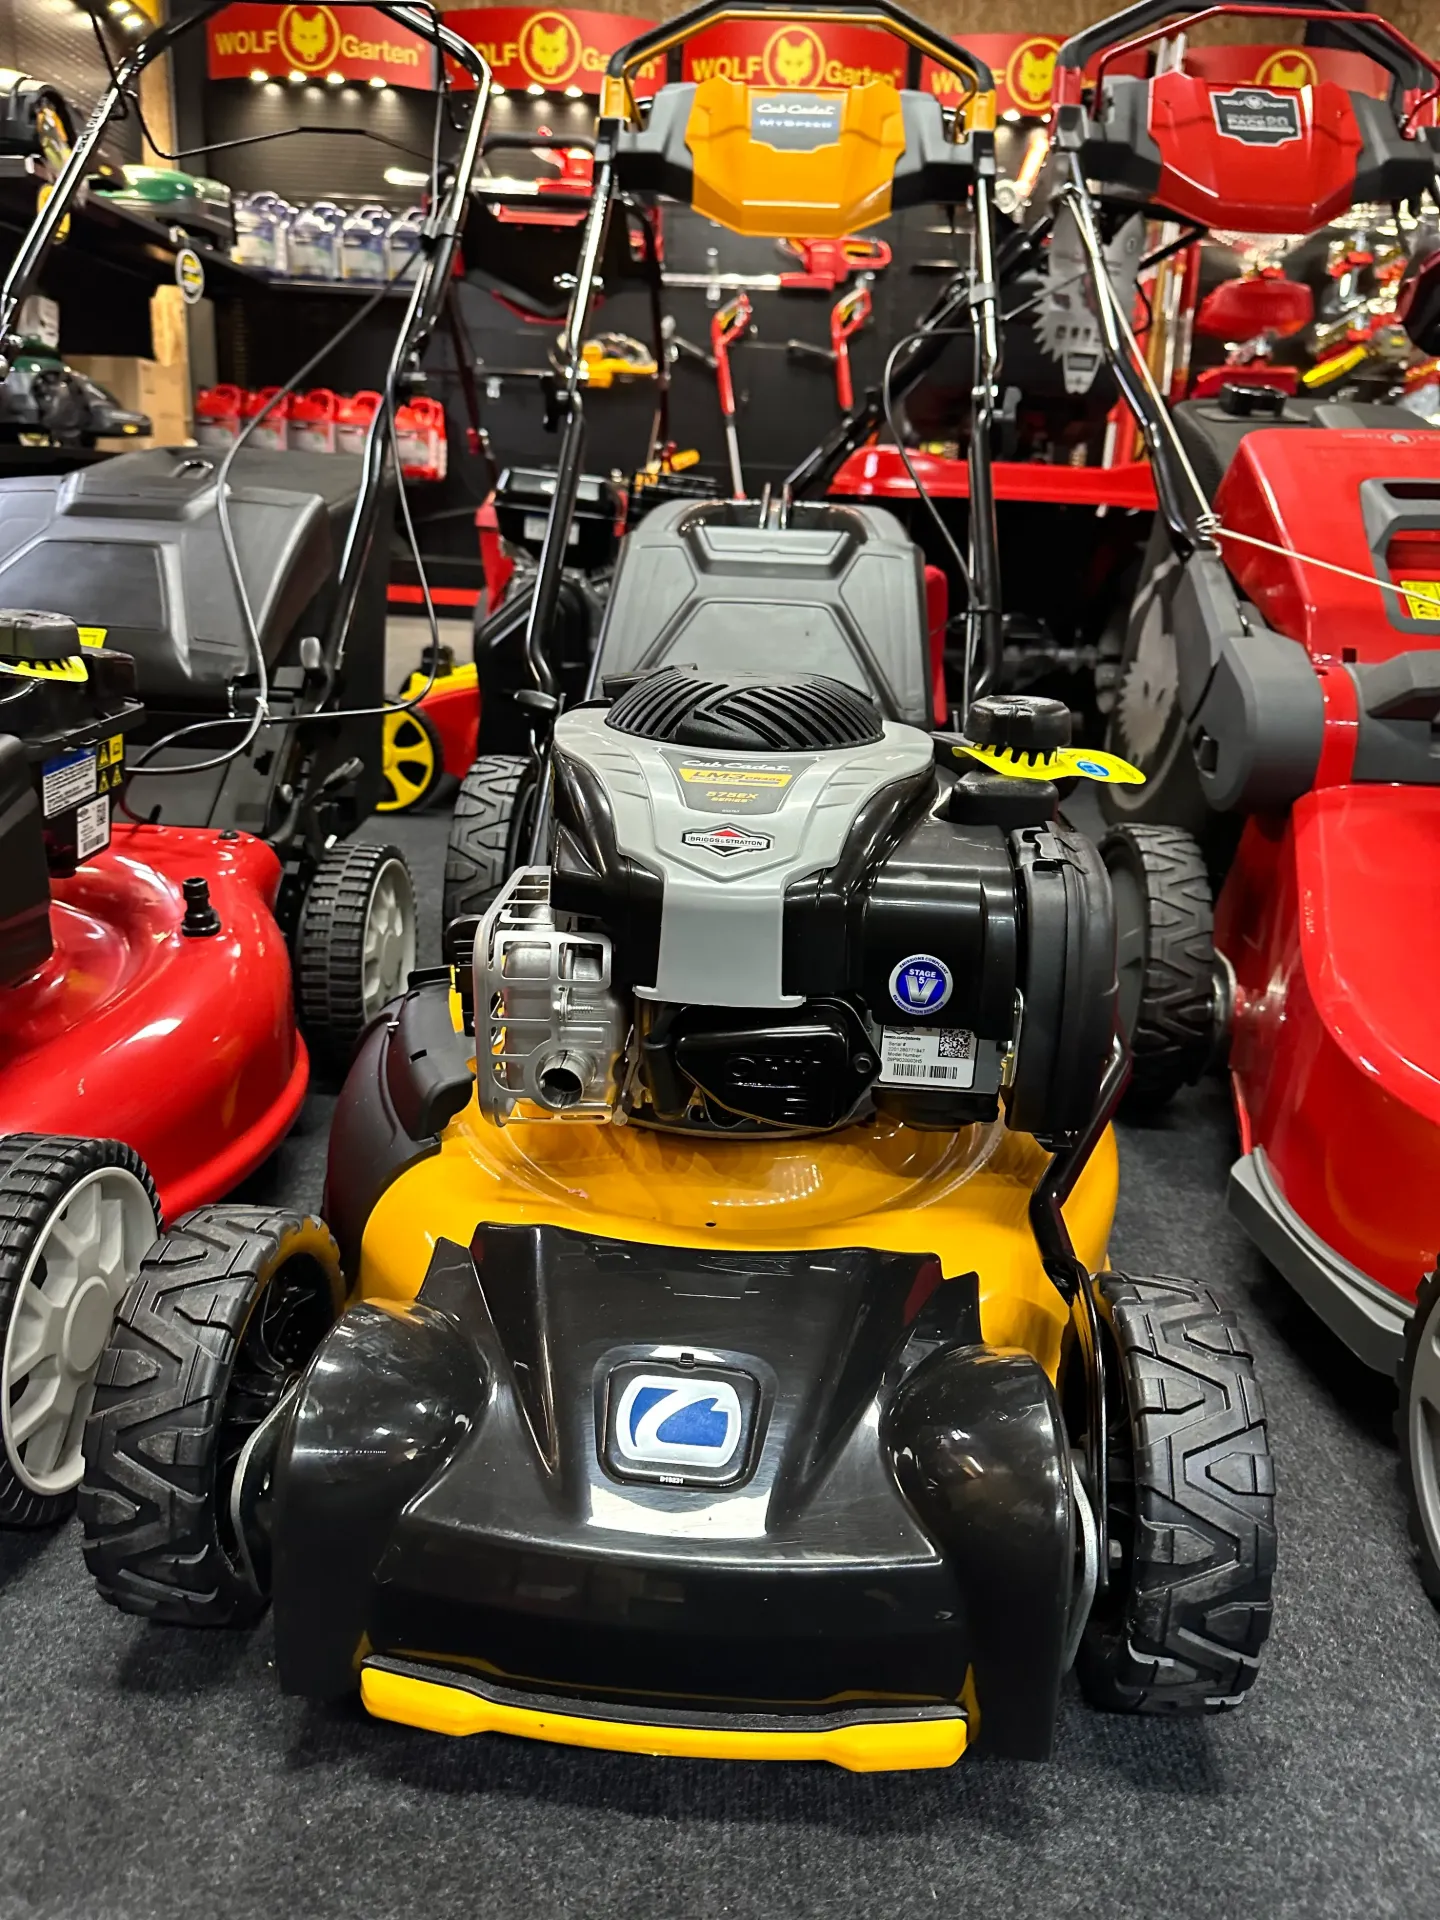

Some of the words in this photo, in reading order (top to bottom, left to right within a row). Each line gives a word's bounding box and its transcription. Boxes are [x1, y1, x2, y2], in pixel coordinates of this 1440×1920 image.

[215, 30, 278, 55] WOLF
[692, 56, 762, 81] WOLF
[681, 760, 722, 769] Cub
[723, 762, 789, 772] Cadet
[692, 771, 745, 779] LM3
[705, 791, 759, 799] 575EX
[909, 968, 936, 978] STAGE
[918, 976, 925, 984] 5
